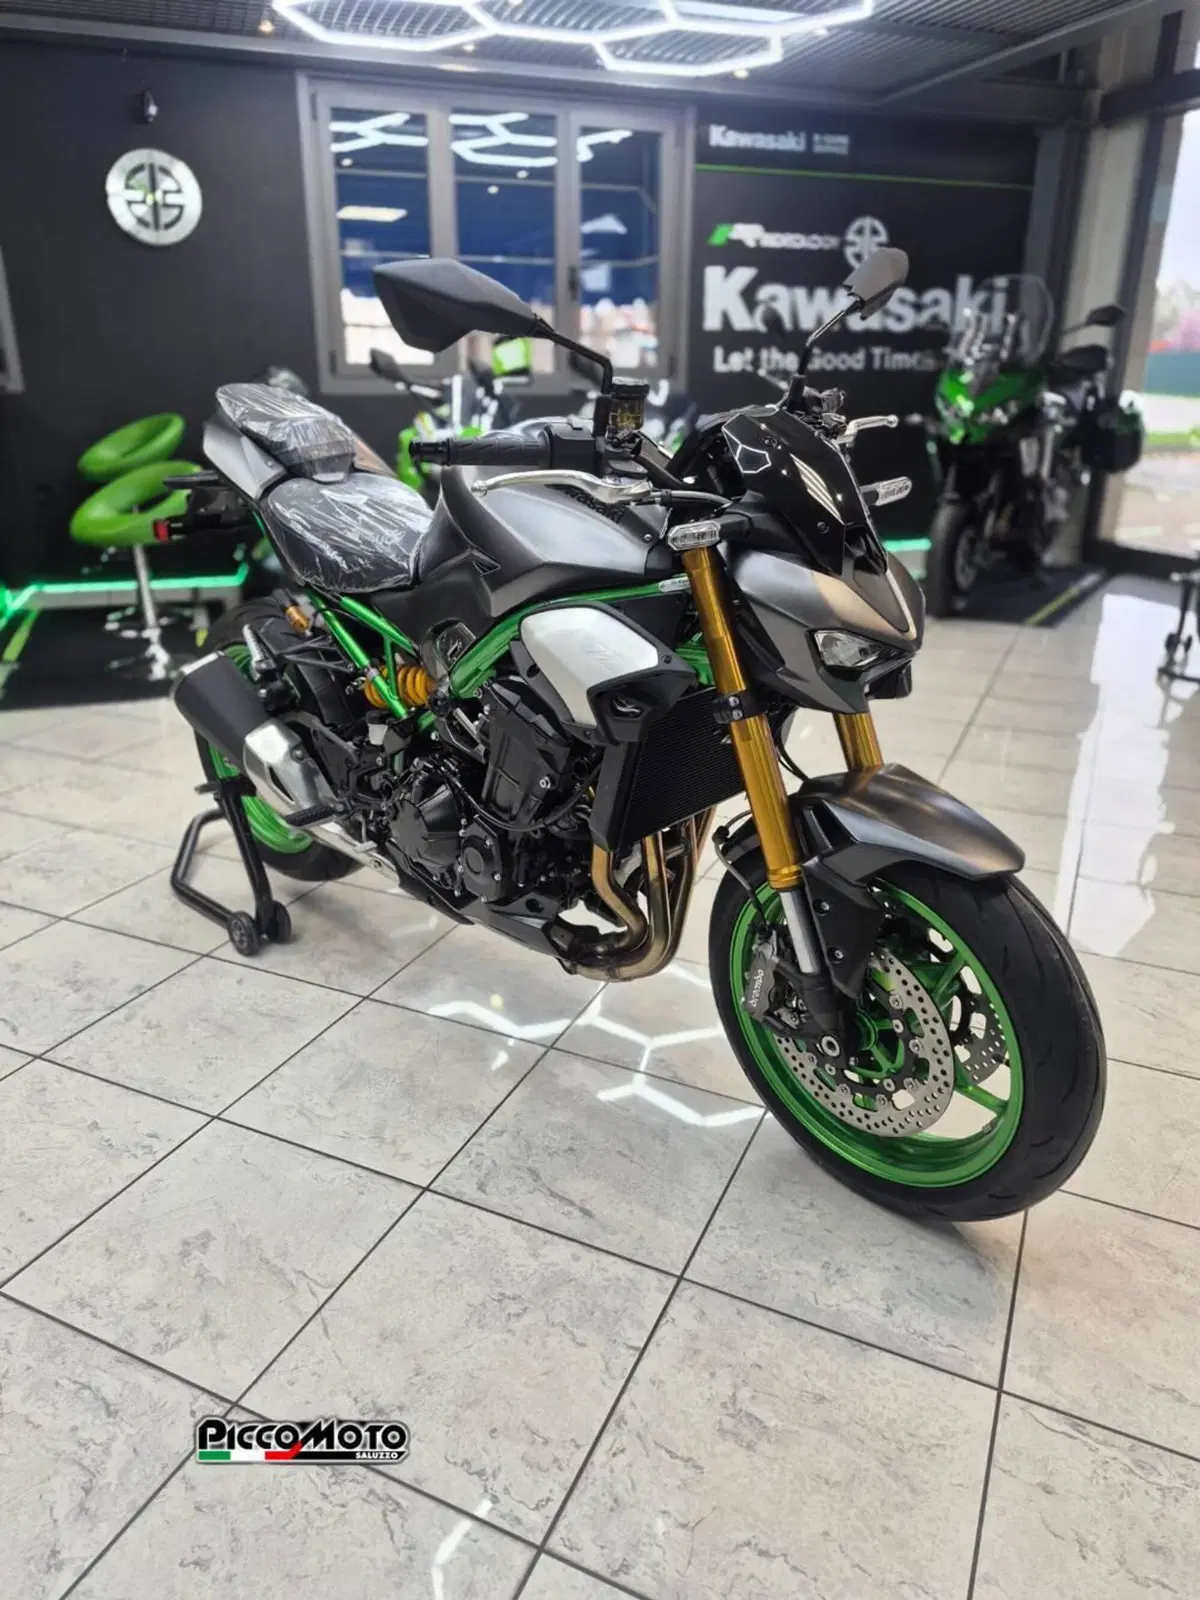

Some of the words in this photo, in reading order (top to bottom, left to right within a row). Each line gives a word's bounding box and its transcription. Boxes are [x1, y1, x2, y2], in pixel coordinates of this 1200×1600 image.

[708, 124, 806, 152] Kawasaki
[713, 345, 754, 372] Let
[760, 346, 799, 372] the
[748, 969, 764, 1008] brembo
